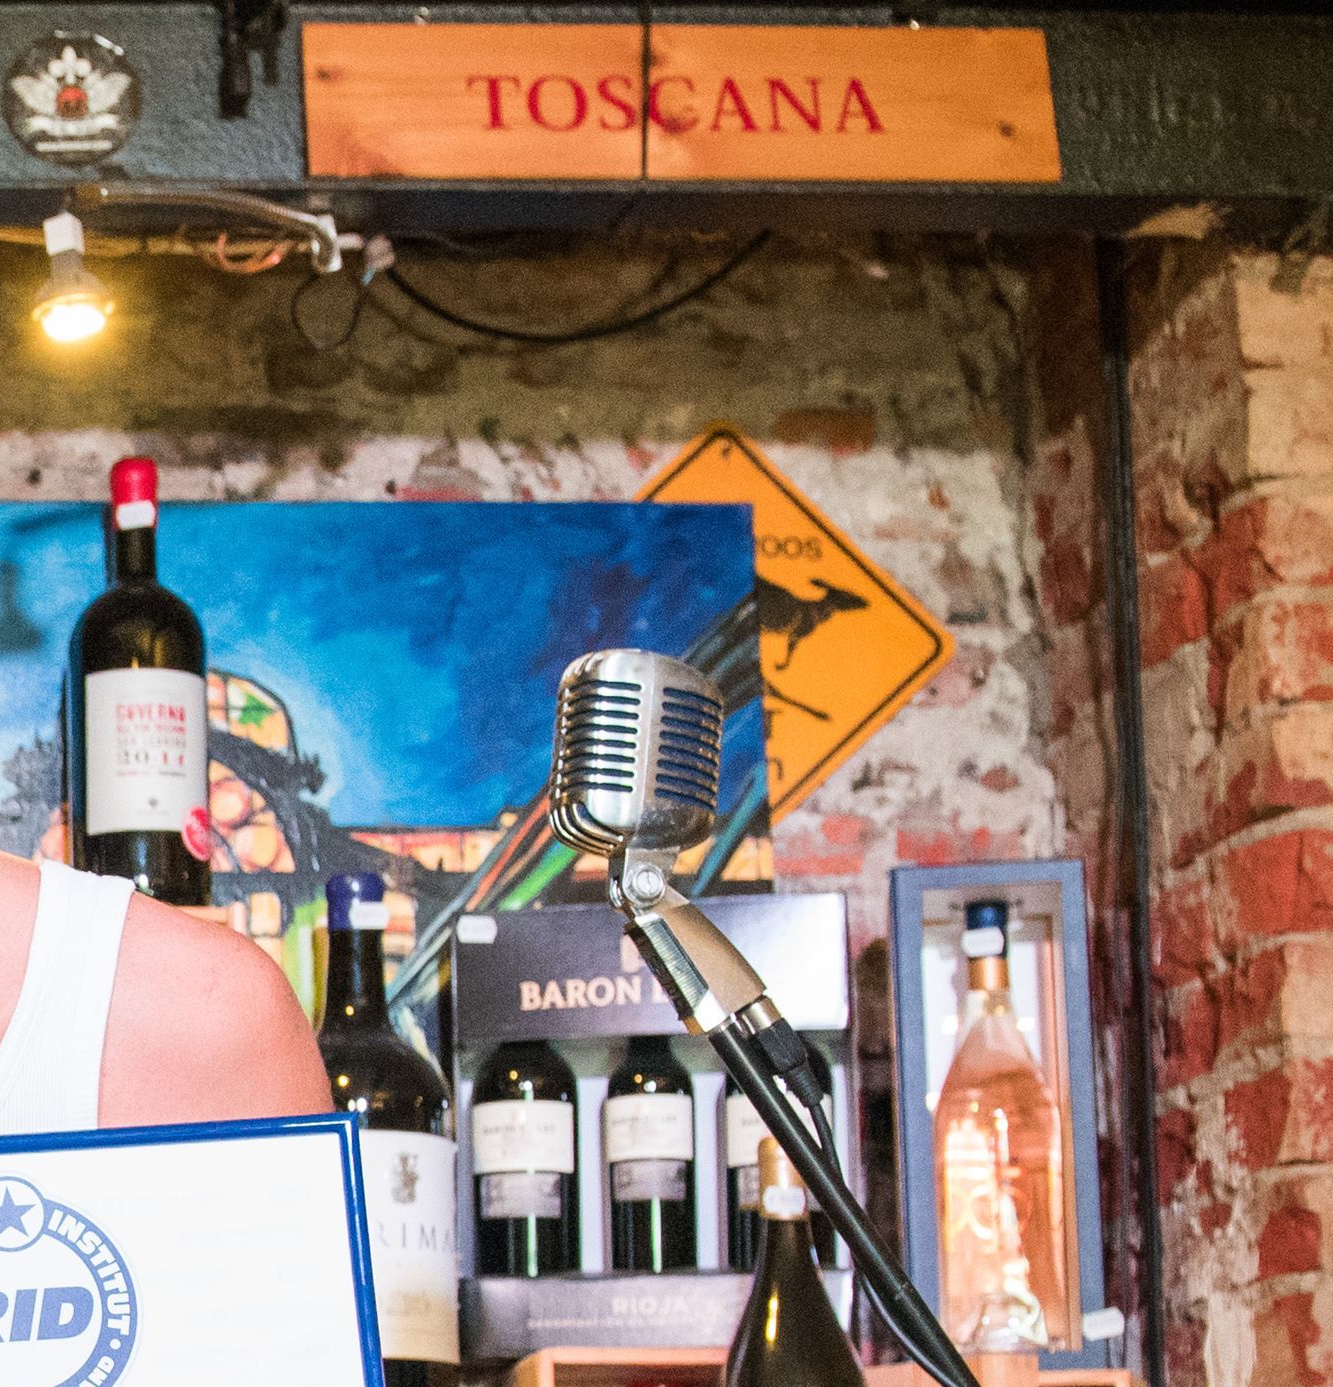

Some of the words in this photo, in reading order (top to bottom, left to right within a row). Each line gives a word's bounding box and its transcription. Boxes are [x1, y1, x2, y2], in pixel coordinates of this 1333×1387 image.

[466, 74, 885, 135] TOSCANA
[519, 975, 642, 1012] BARON
[47, 1209, 131, 1336] INSTITUT
